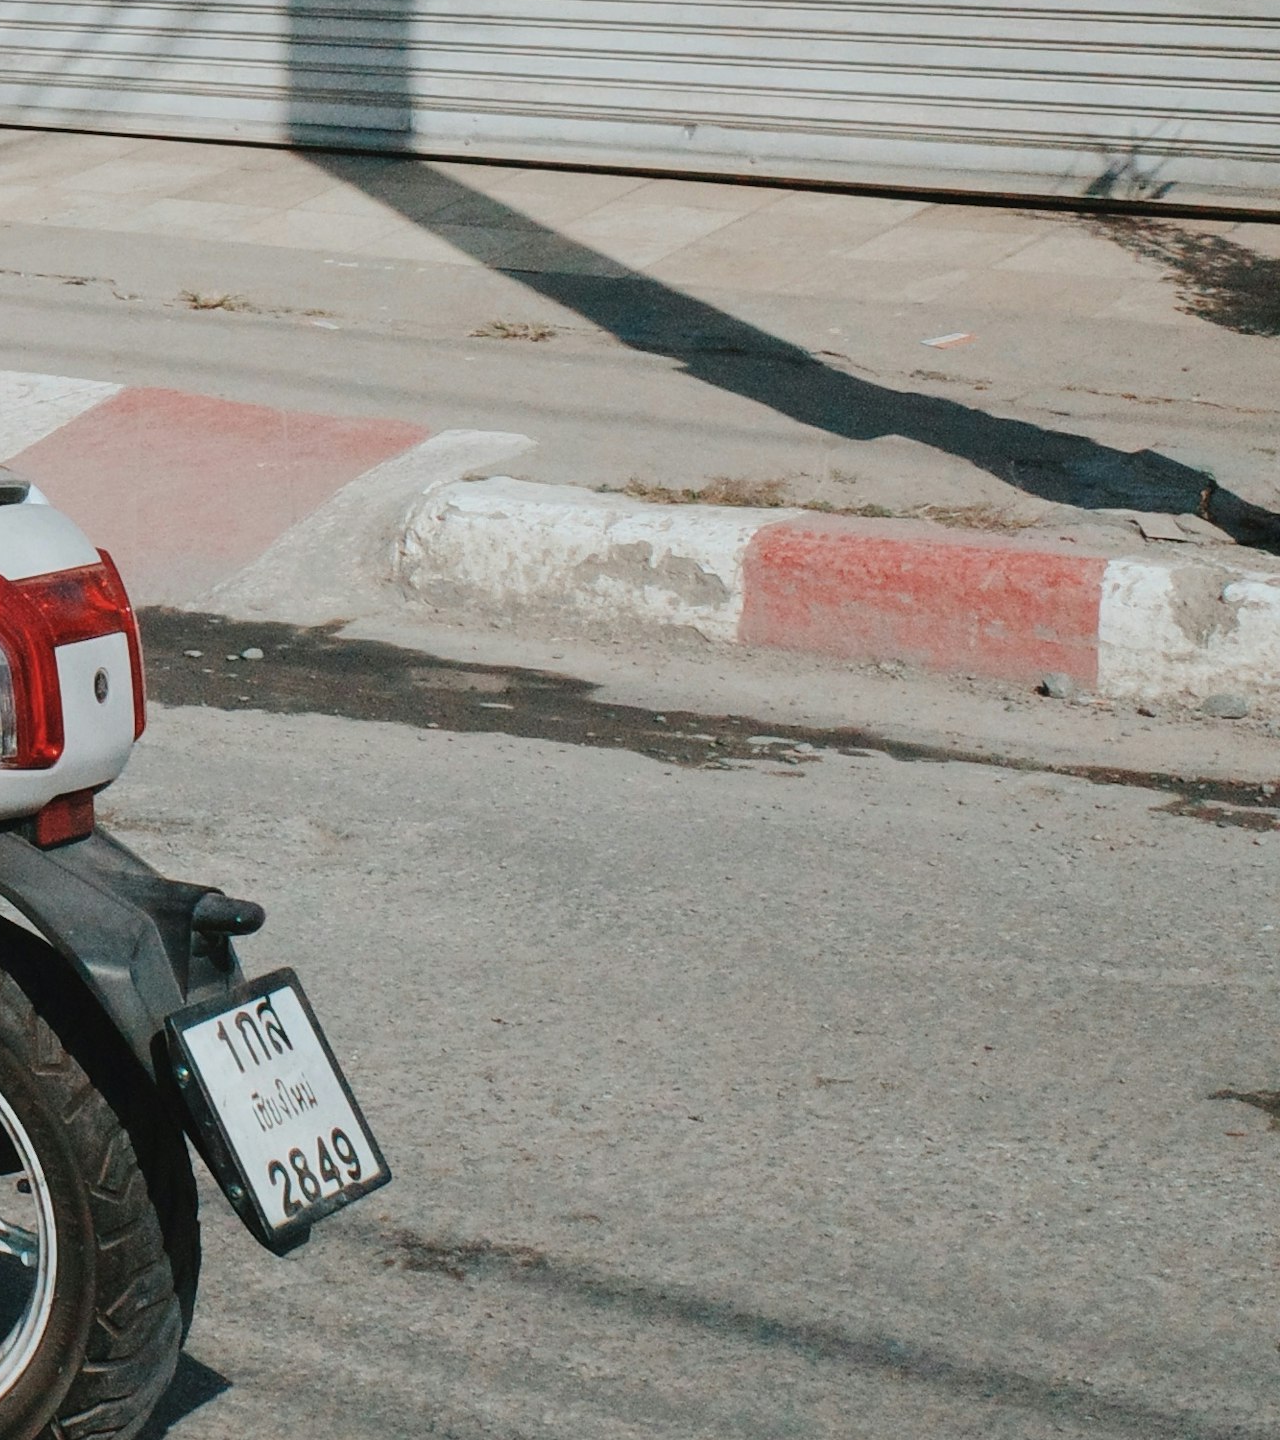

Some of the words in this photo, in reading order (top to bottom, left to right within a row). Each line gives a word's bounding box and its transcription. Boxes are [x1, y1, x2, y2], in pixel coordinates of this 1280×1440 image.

[216, 994, 294, 1074] 1กส
[251, 1073, 319, 1132] เชียงใหม่
[267, 1126, 362, 1219] 2849
